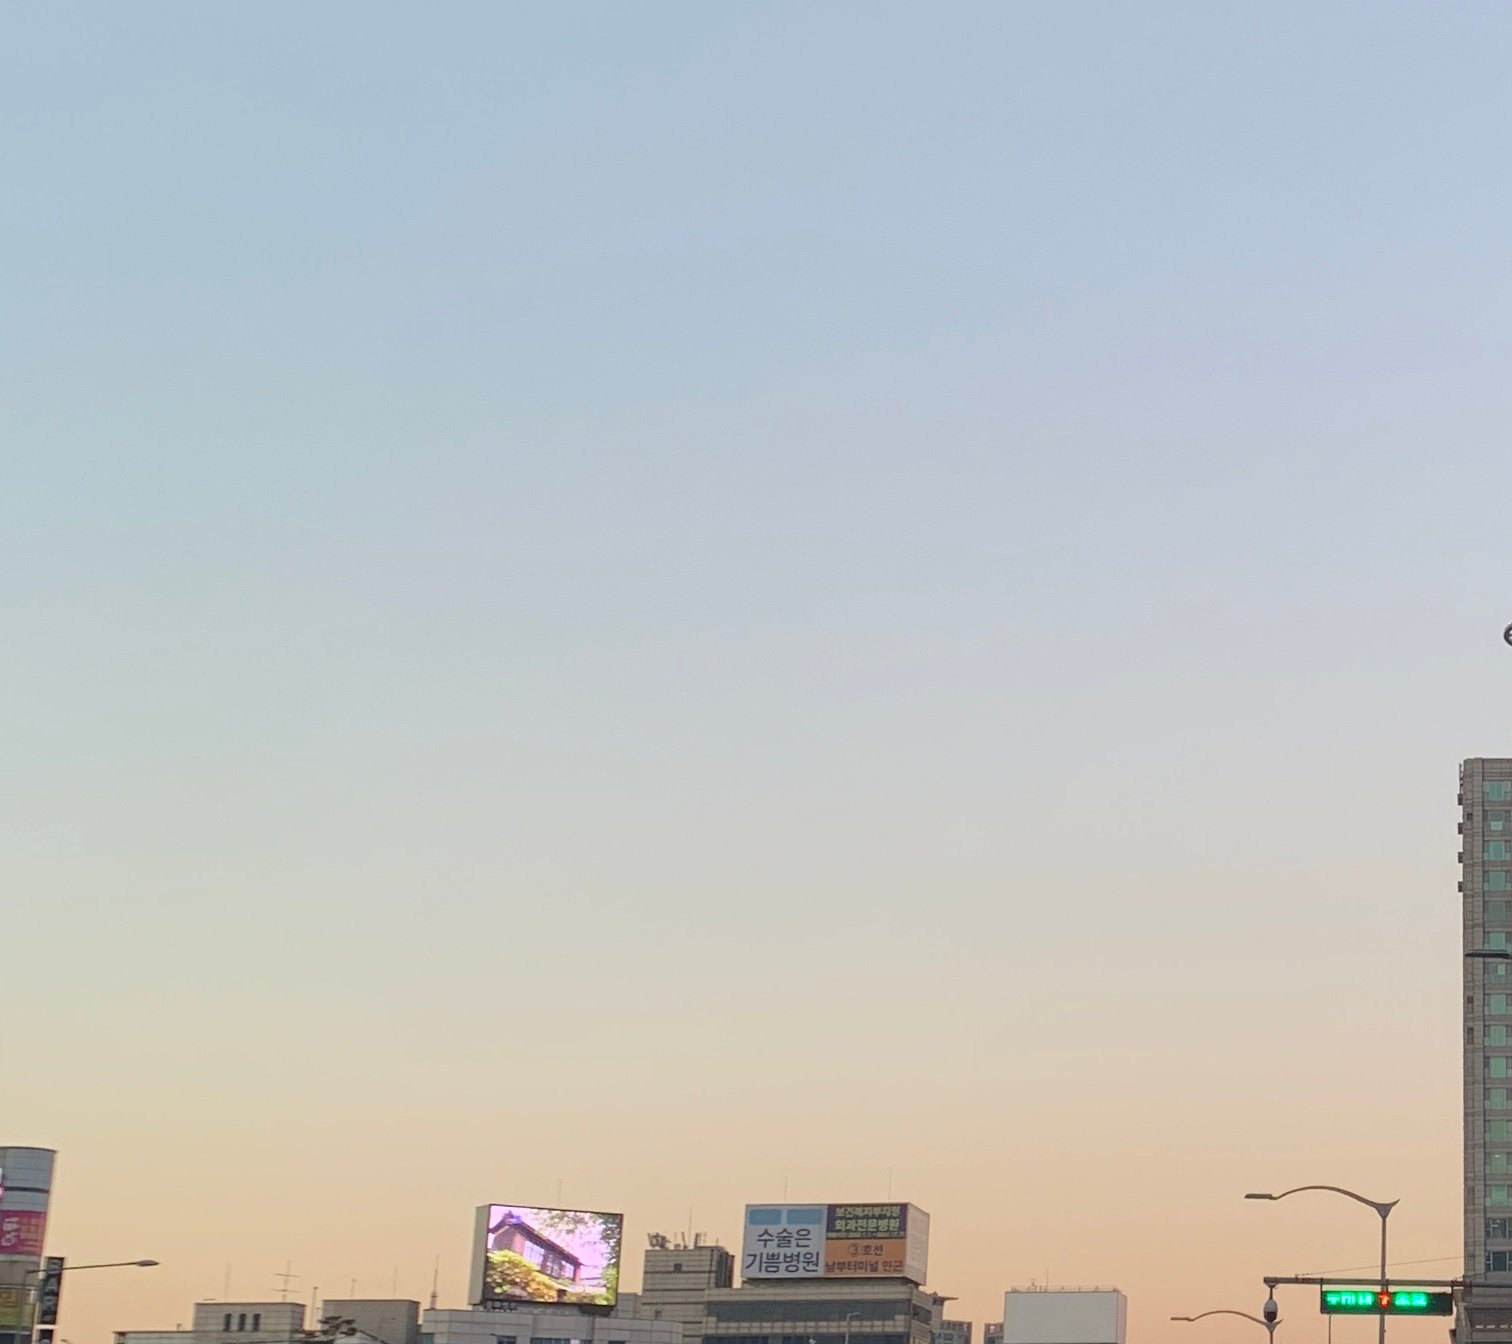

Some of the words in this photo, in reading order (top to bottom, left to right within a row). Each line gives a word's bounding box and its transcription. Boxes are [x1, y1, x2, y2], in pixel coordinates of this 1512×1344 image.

[835, 1218, 900, 1232] 외과전문병원
[757, 1228, 812, 1249] 수술은
[745, 1251, 820, 1274] 기쁨병원
[825, 1260, 879, 1273] 남부터미널
[882, 1260, 904, 1273] 인근
